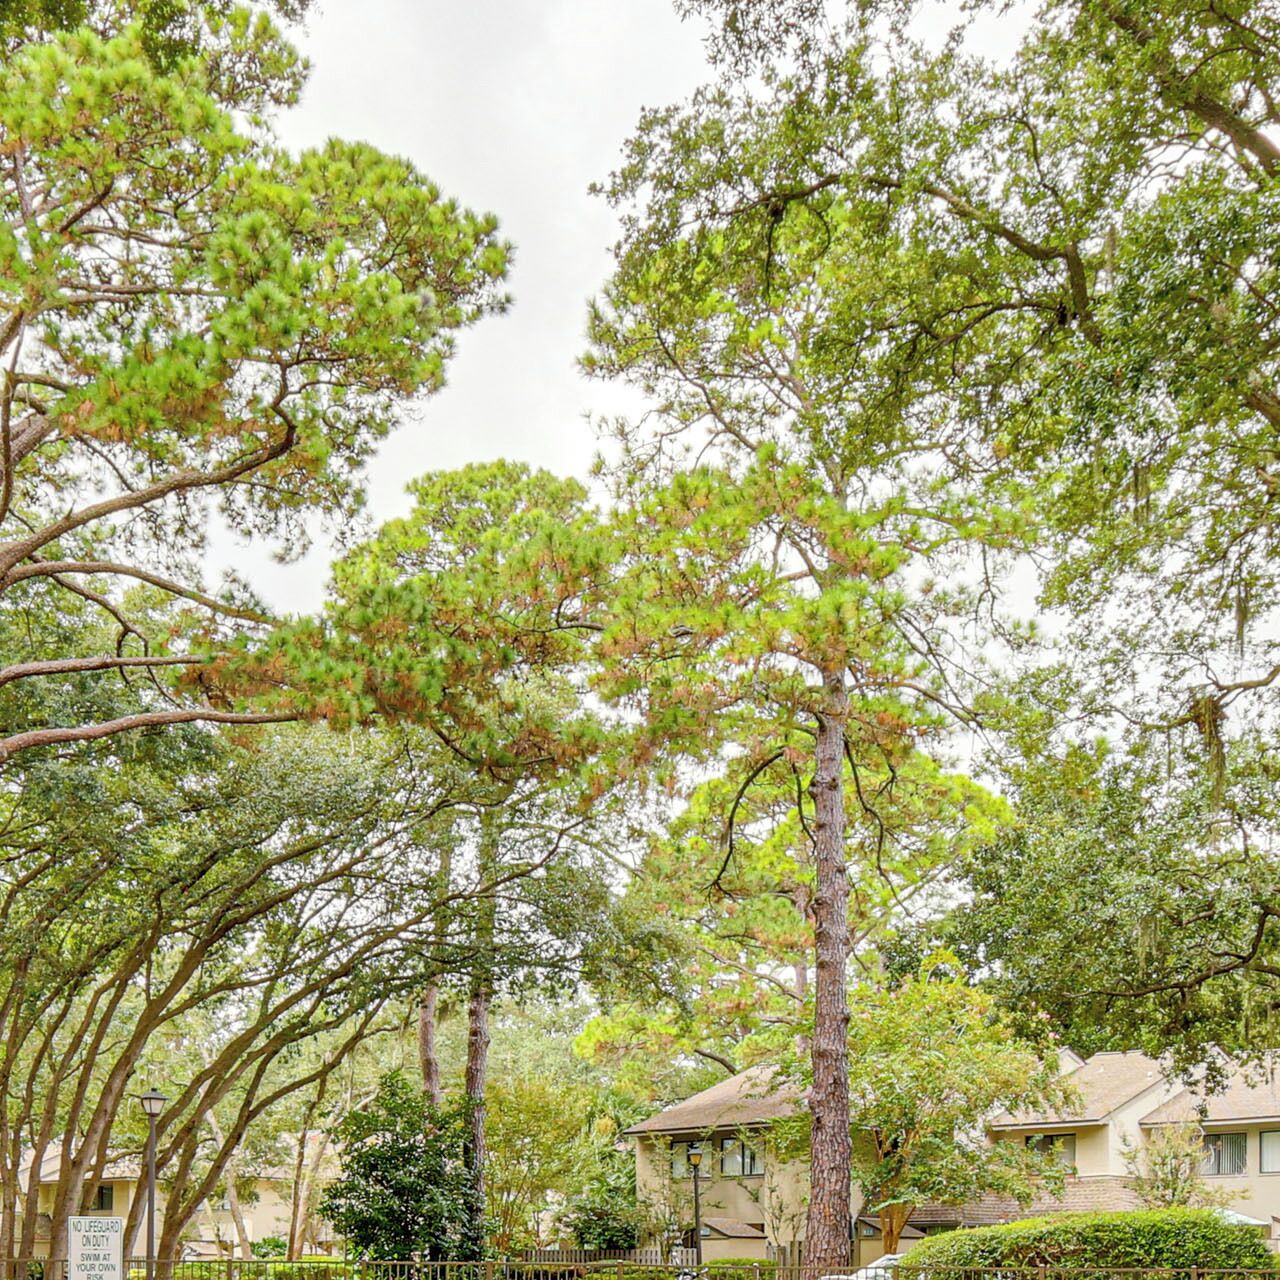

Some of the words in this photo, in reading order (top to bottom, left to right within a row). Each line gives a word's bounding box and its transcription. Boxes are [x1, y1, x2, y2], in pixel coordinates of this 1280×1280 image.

[72, 1220, 81, 1232] NO
[85, 1220, 119, 1233] LIFEGUARD
[82, 1234, 91, 1247] ON
[92, 1234, 110, 1247] DUTY
[80, 1253, 100, 1262] SWIM
[102, 1253, 112, 1262] AT
[76, 1263, 96, 1272] YOUR
[98, 1263, 116, 1272] OWN
